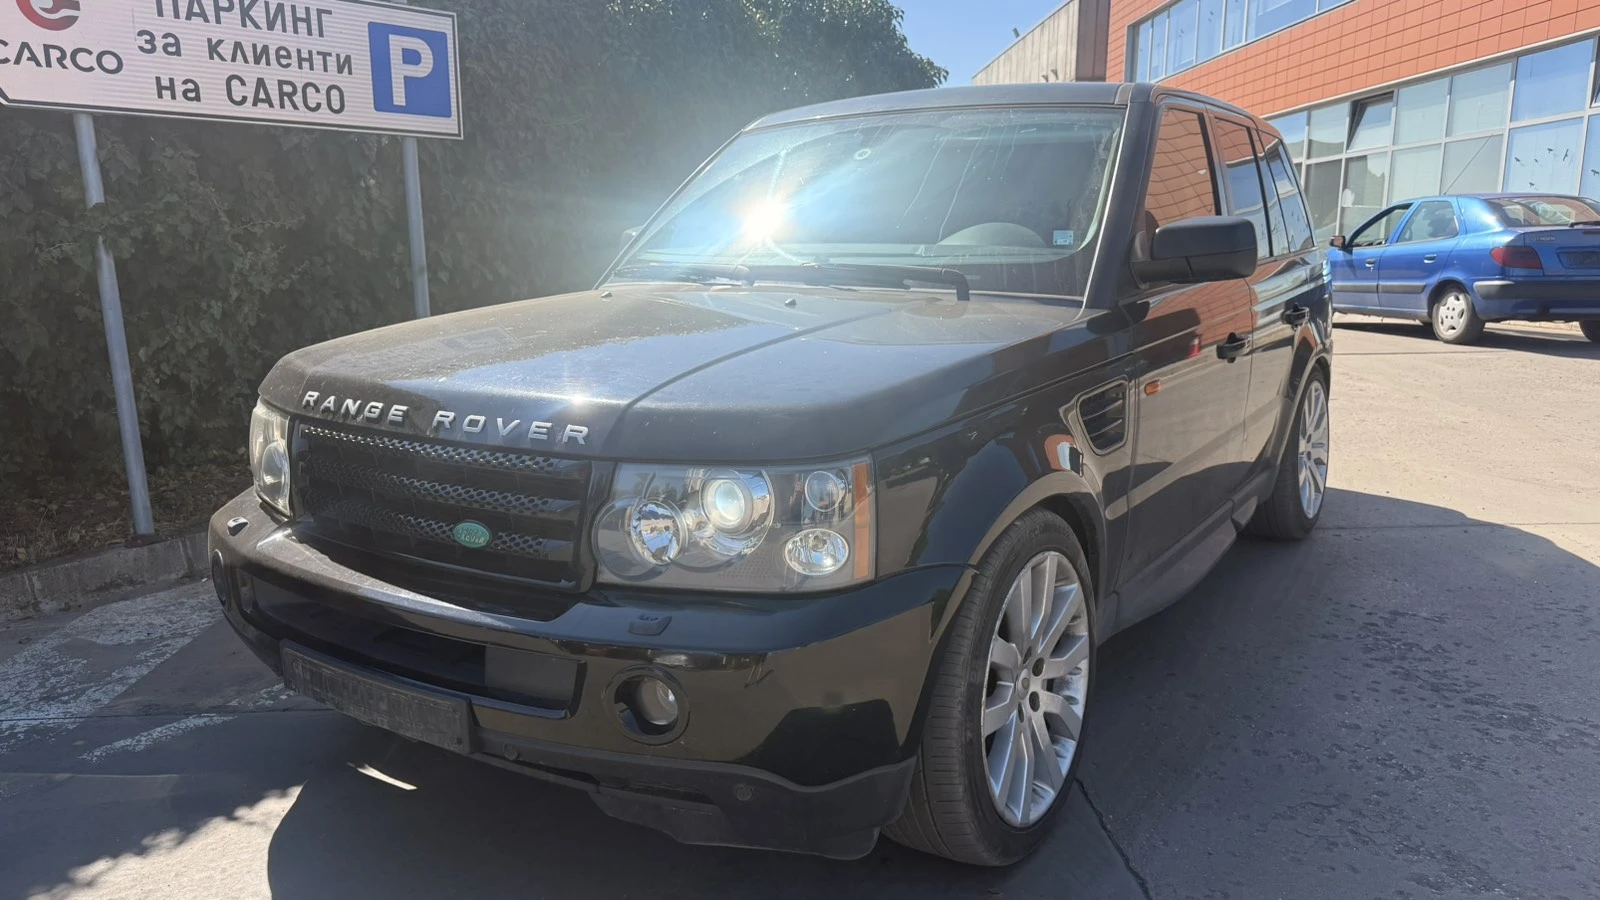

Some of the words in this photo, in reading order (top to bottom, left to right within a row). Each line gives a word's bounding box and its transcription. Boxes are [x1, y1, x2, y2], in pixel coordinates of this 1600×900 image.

[155, 0, 333, 38] ПАРКИНГ
[136, 29, 182, 58] за
[206, 37, 353, 76] клиенти
[388, 33, 434, 107] P
[155, 75, 202, 103] на
[225, 74, 346, 115] CARCO
[302, 391, 409, 422] RANGE
[431, 410, 589, 445] ROVER
